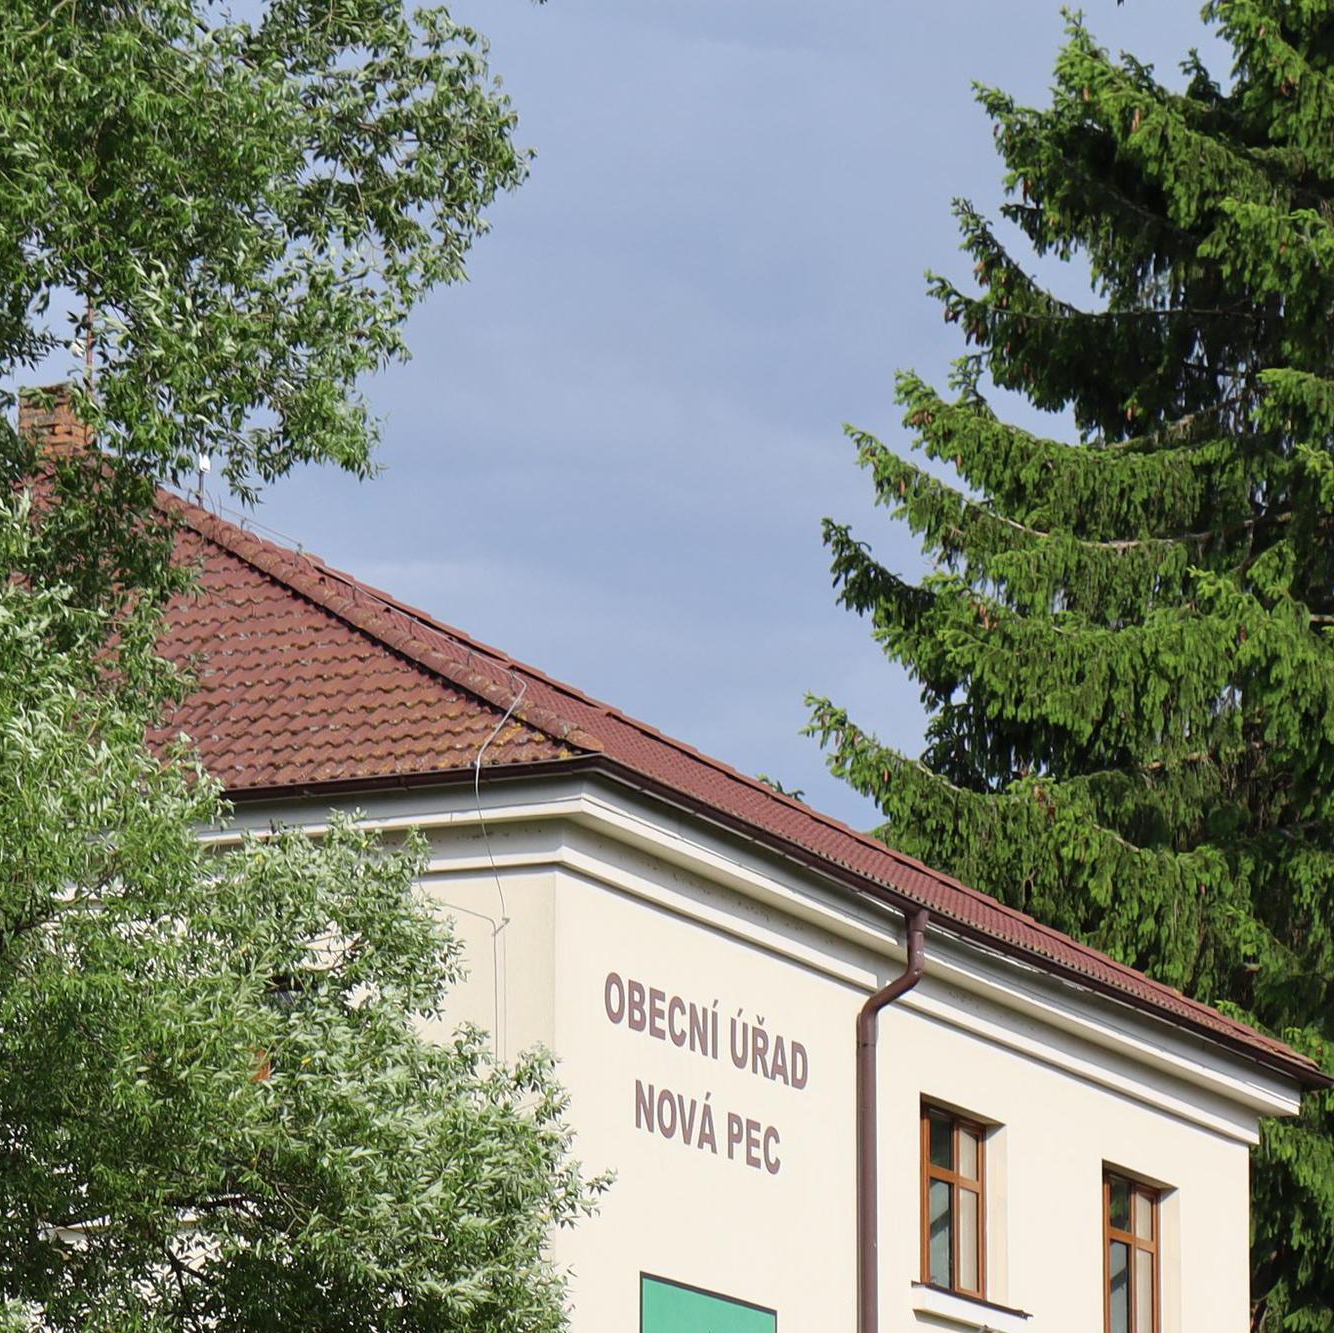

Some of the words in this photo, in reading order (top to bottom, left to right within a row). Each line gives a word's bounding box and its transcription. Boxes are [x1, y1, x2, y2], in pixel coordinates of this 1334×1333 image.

[604, 972, 719, 1060] OBECNÍ
[730, 1008, 809, 1090] ÚŘAD
[635, 1079, 718, 1155] NOVÁ
[727, 1111, 782, 1175] PEC
